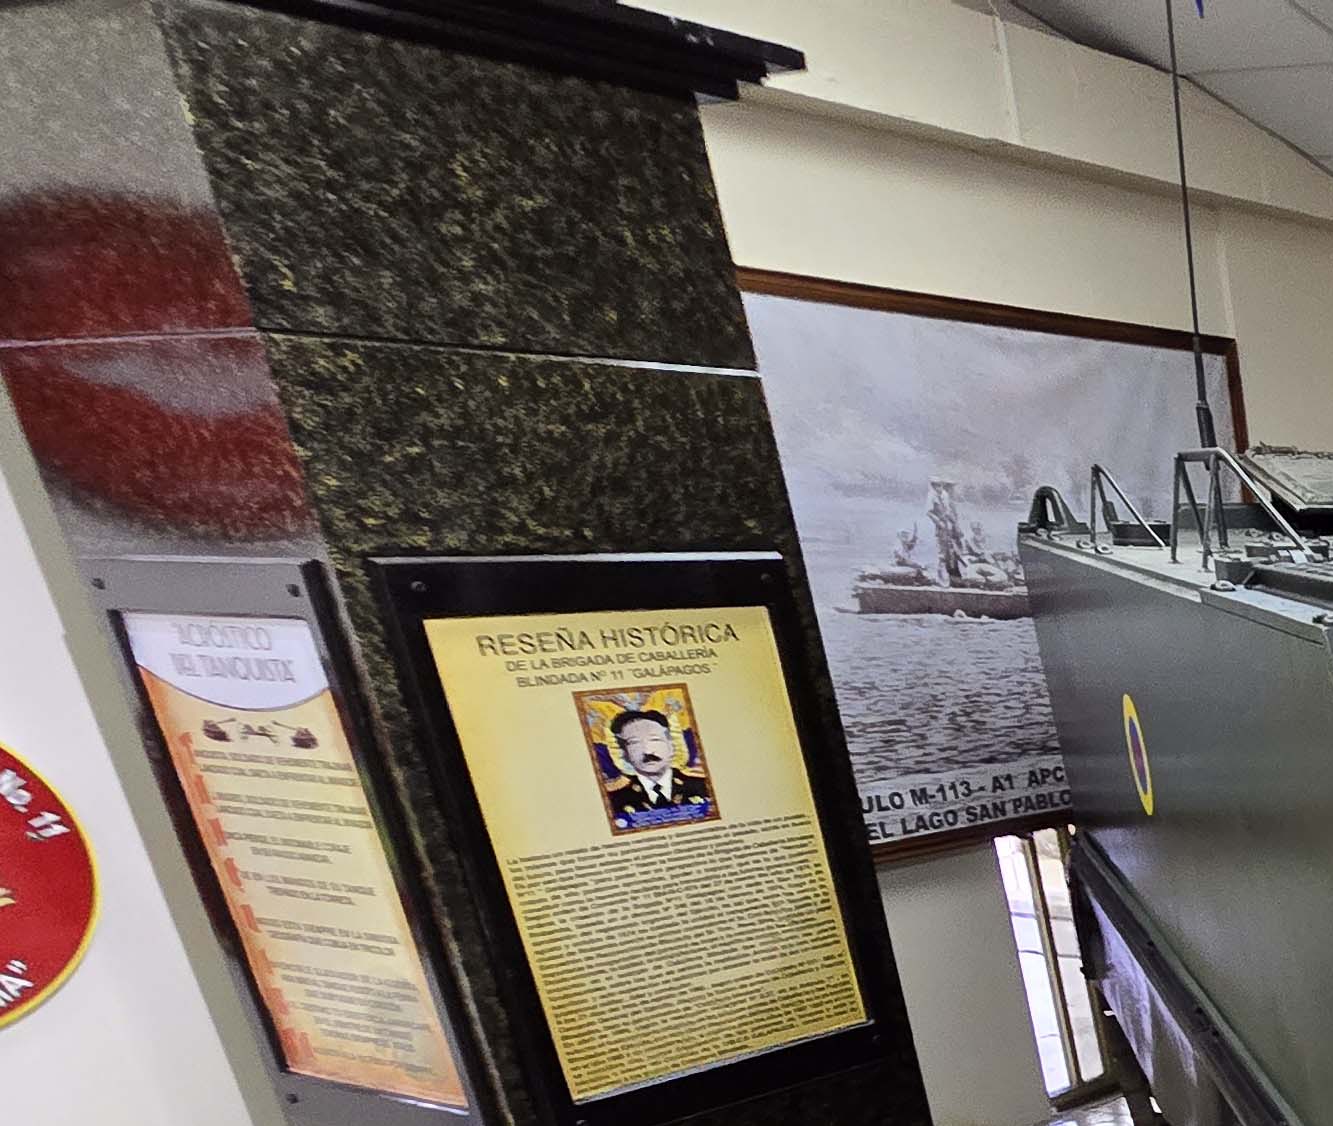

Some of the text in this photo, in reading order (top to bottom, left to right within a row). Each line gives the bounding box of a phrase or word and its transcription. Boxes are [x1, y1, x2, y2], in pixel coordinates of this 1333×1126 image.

[476, 621, 739, 656] RESEÑA HISTÓRICA
[505, 645, 719, 672] DE LA BRIGADA DE CABALLERÍA
[516, 672, 589, 687] BLINDADA
[611, 670, 624, 681] 11
[992, 773, 1014, 793] A1
[1028, 766, 1065, 788] APC
[901, 809, 959, 835] LAGO
[965, 801, 1007, 823] SAN
[1013, 789, 1072, 814] PABLO
